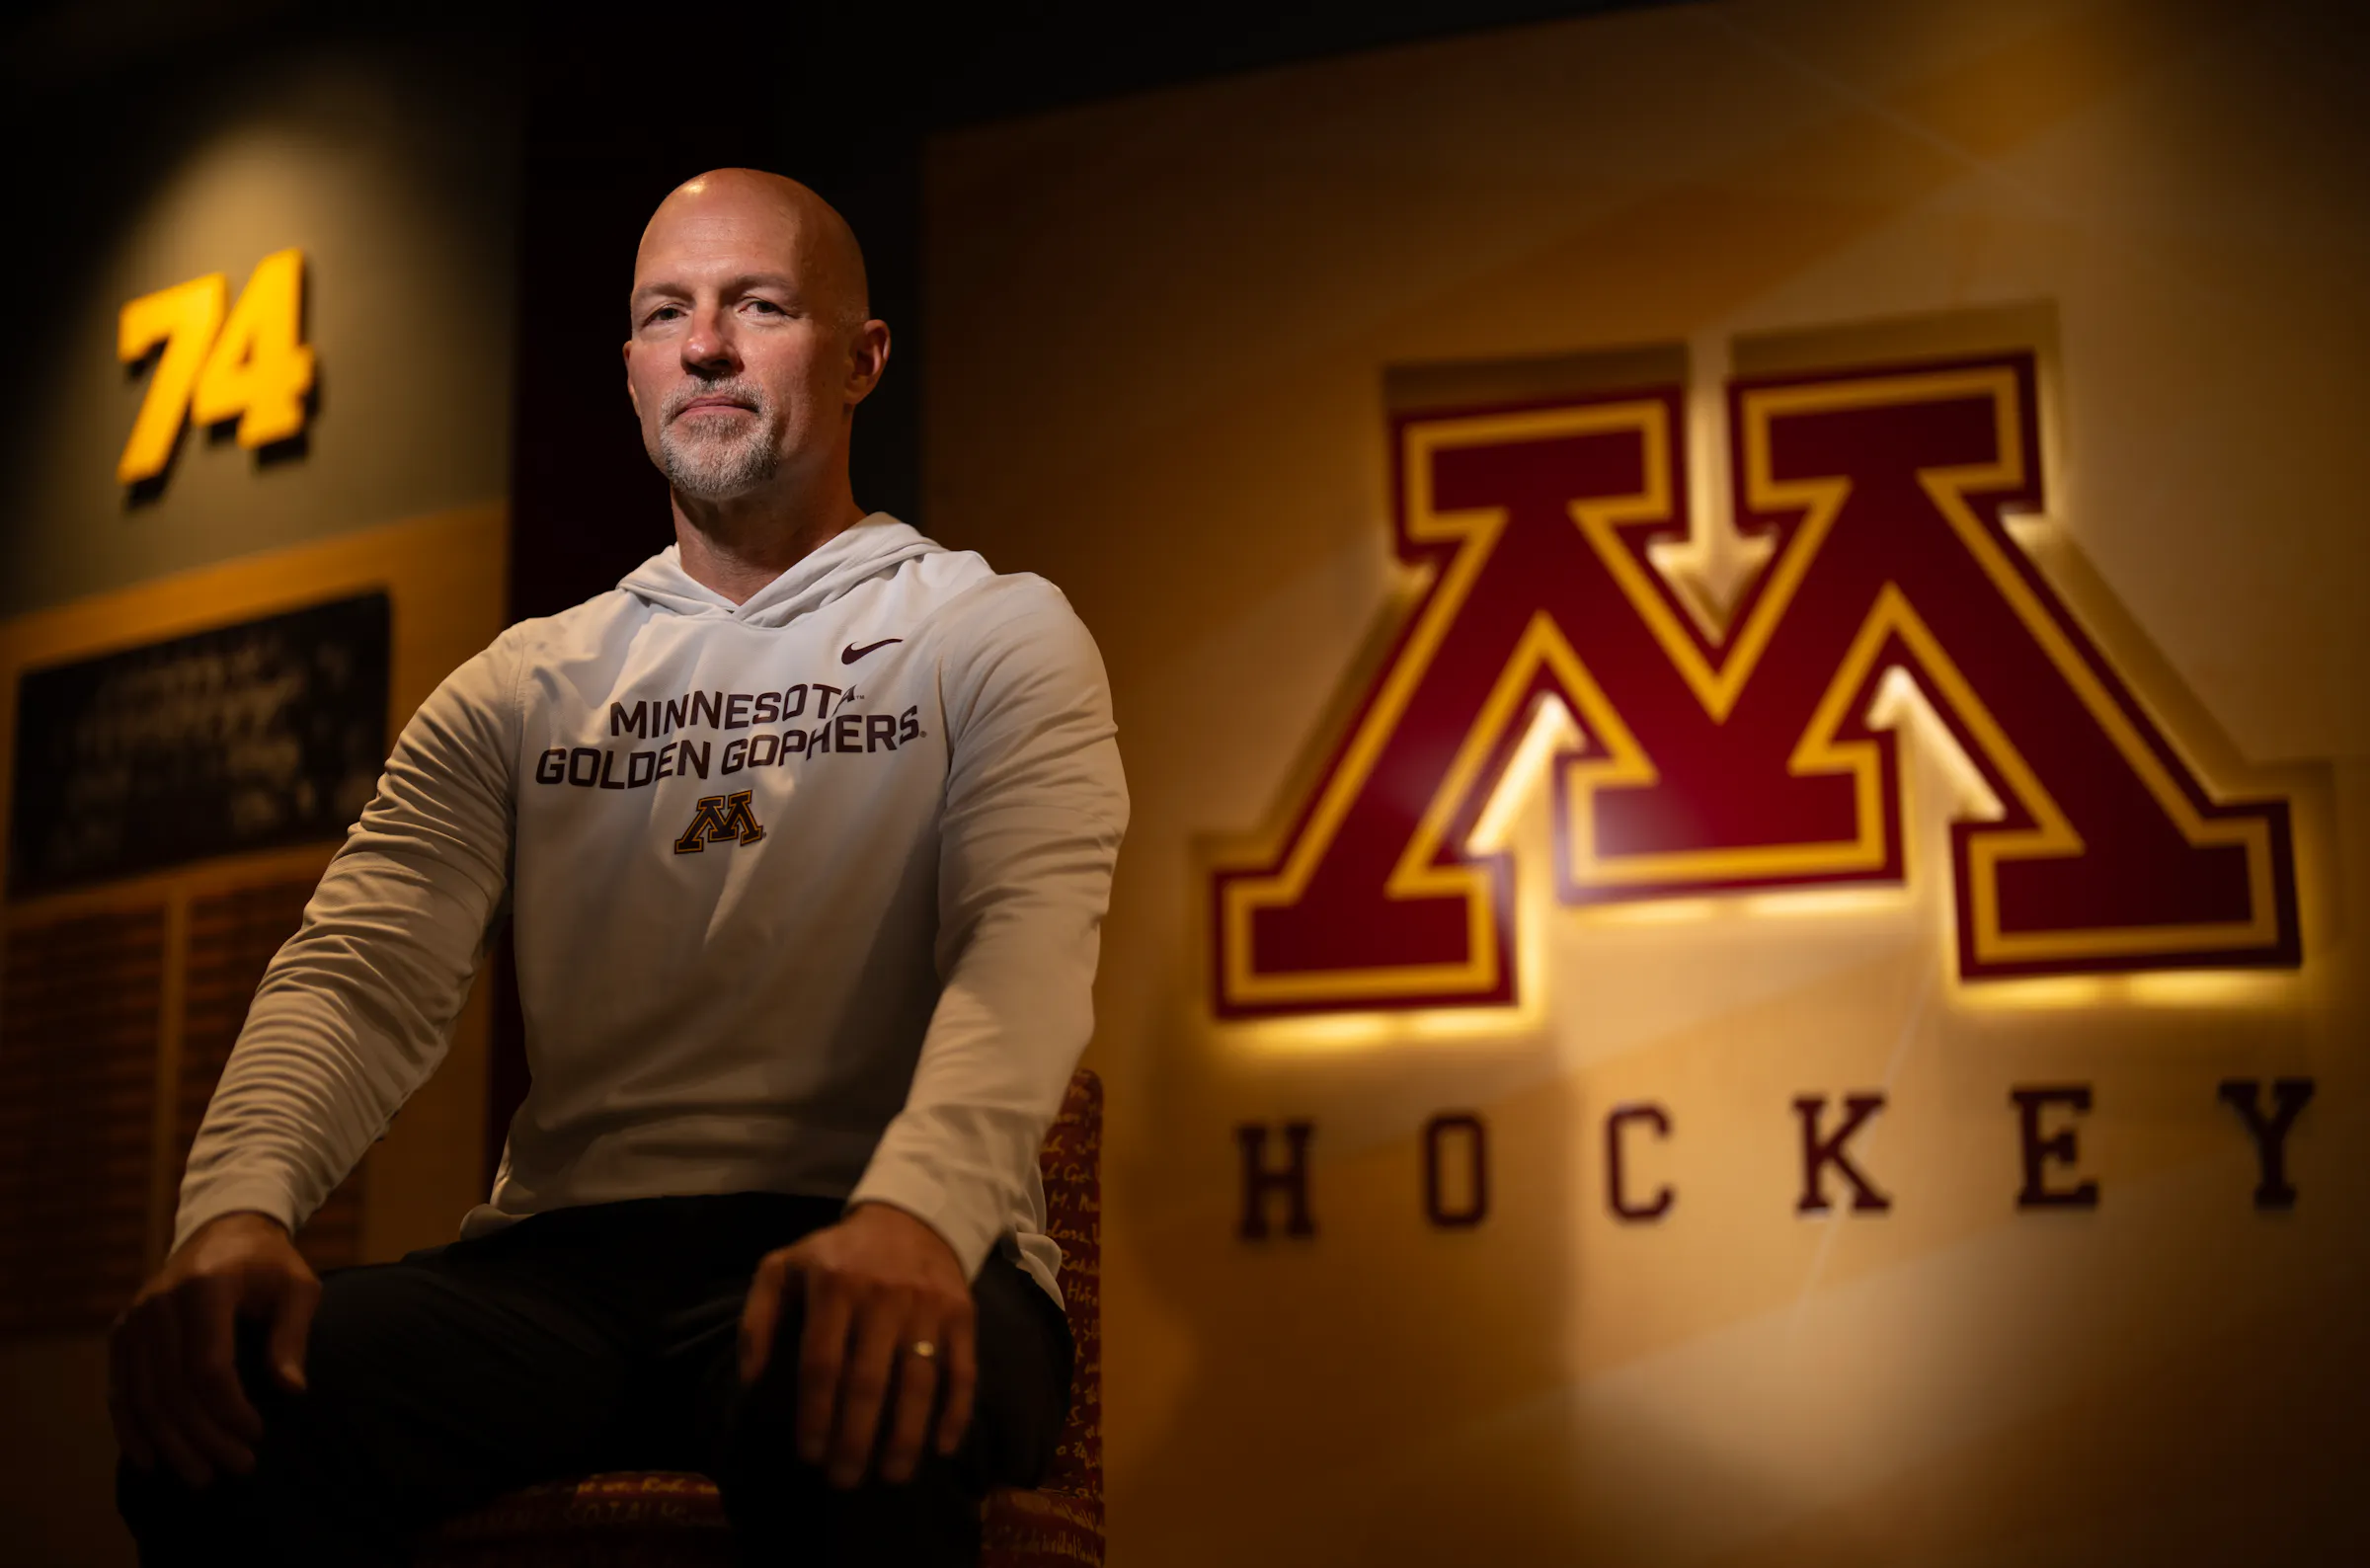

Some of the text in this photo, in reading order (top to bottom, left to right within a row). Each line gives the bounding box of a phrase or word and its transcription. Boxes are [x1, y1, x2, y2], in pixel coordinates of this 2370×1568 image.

[117, 247, 314, 486] 74
[535, 705, 919, 789] GOLDEN GOPHERS
[1210, 350, 2304, 1019] M
[674, 789, 763, 854] M
[1235, 1077, 2317, 1242] HOCKEY
